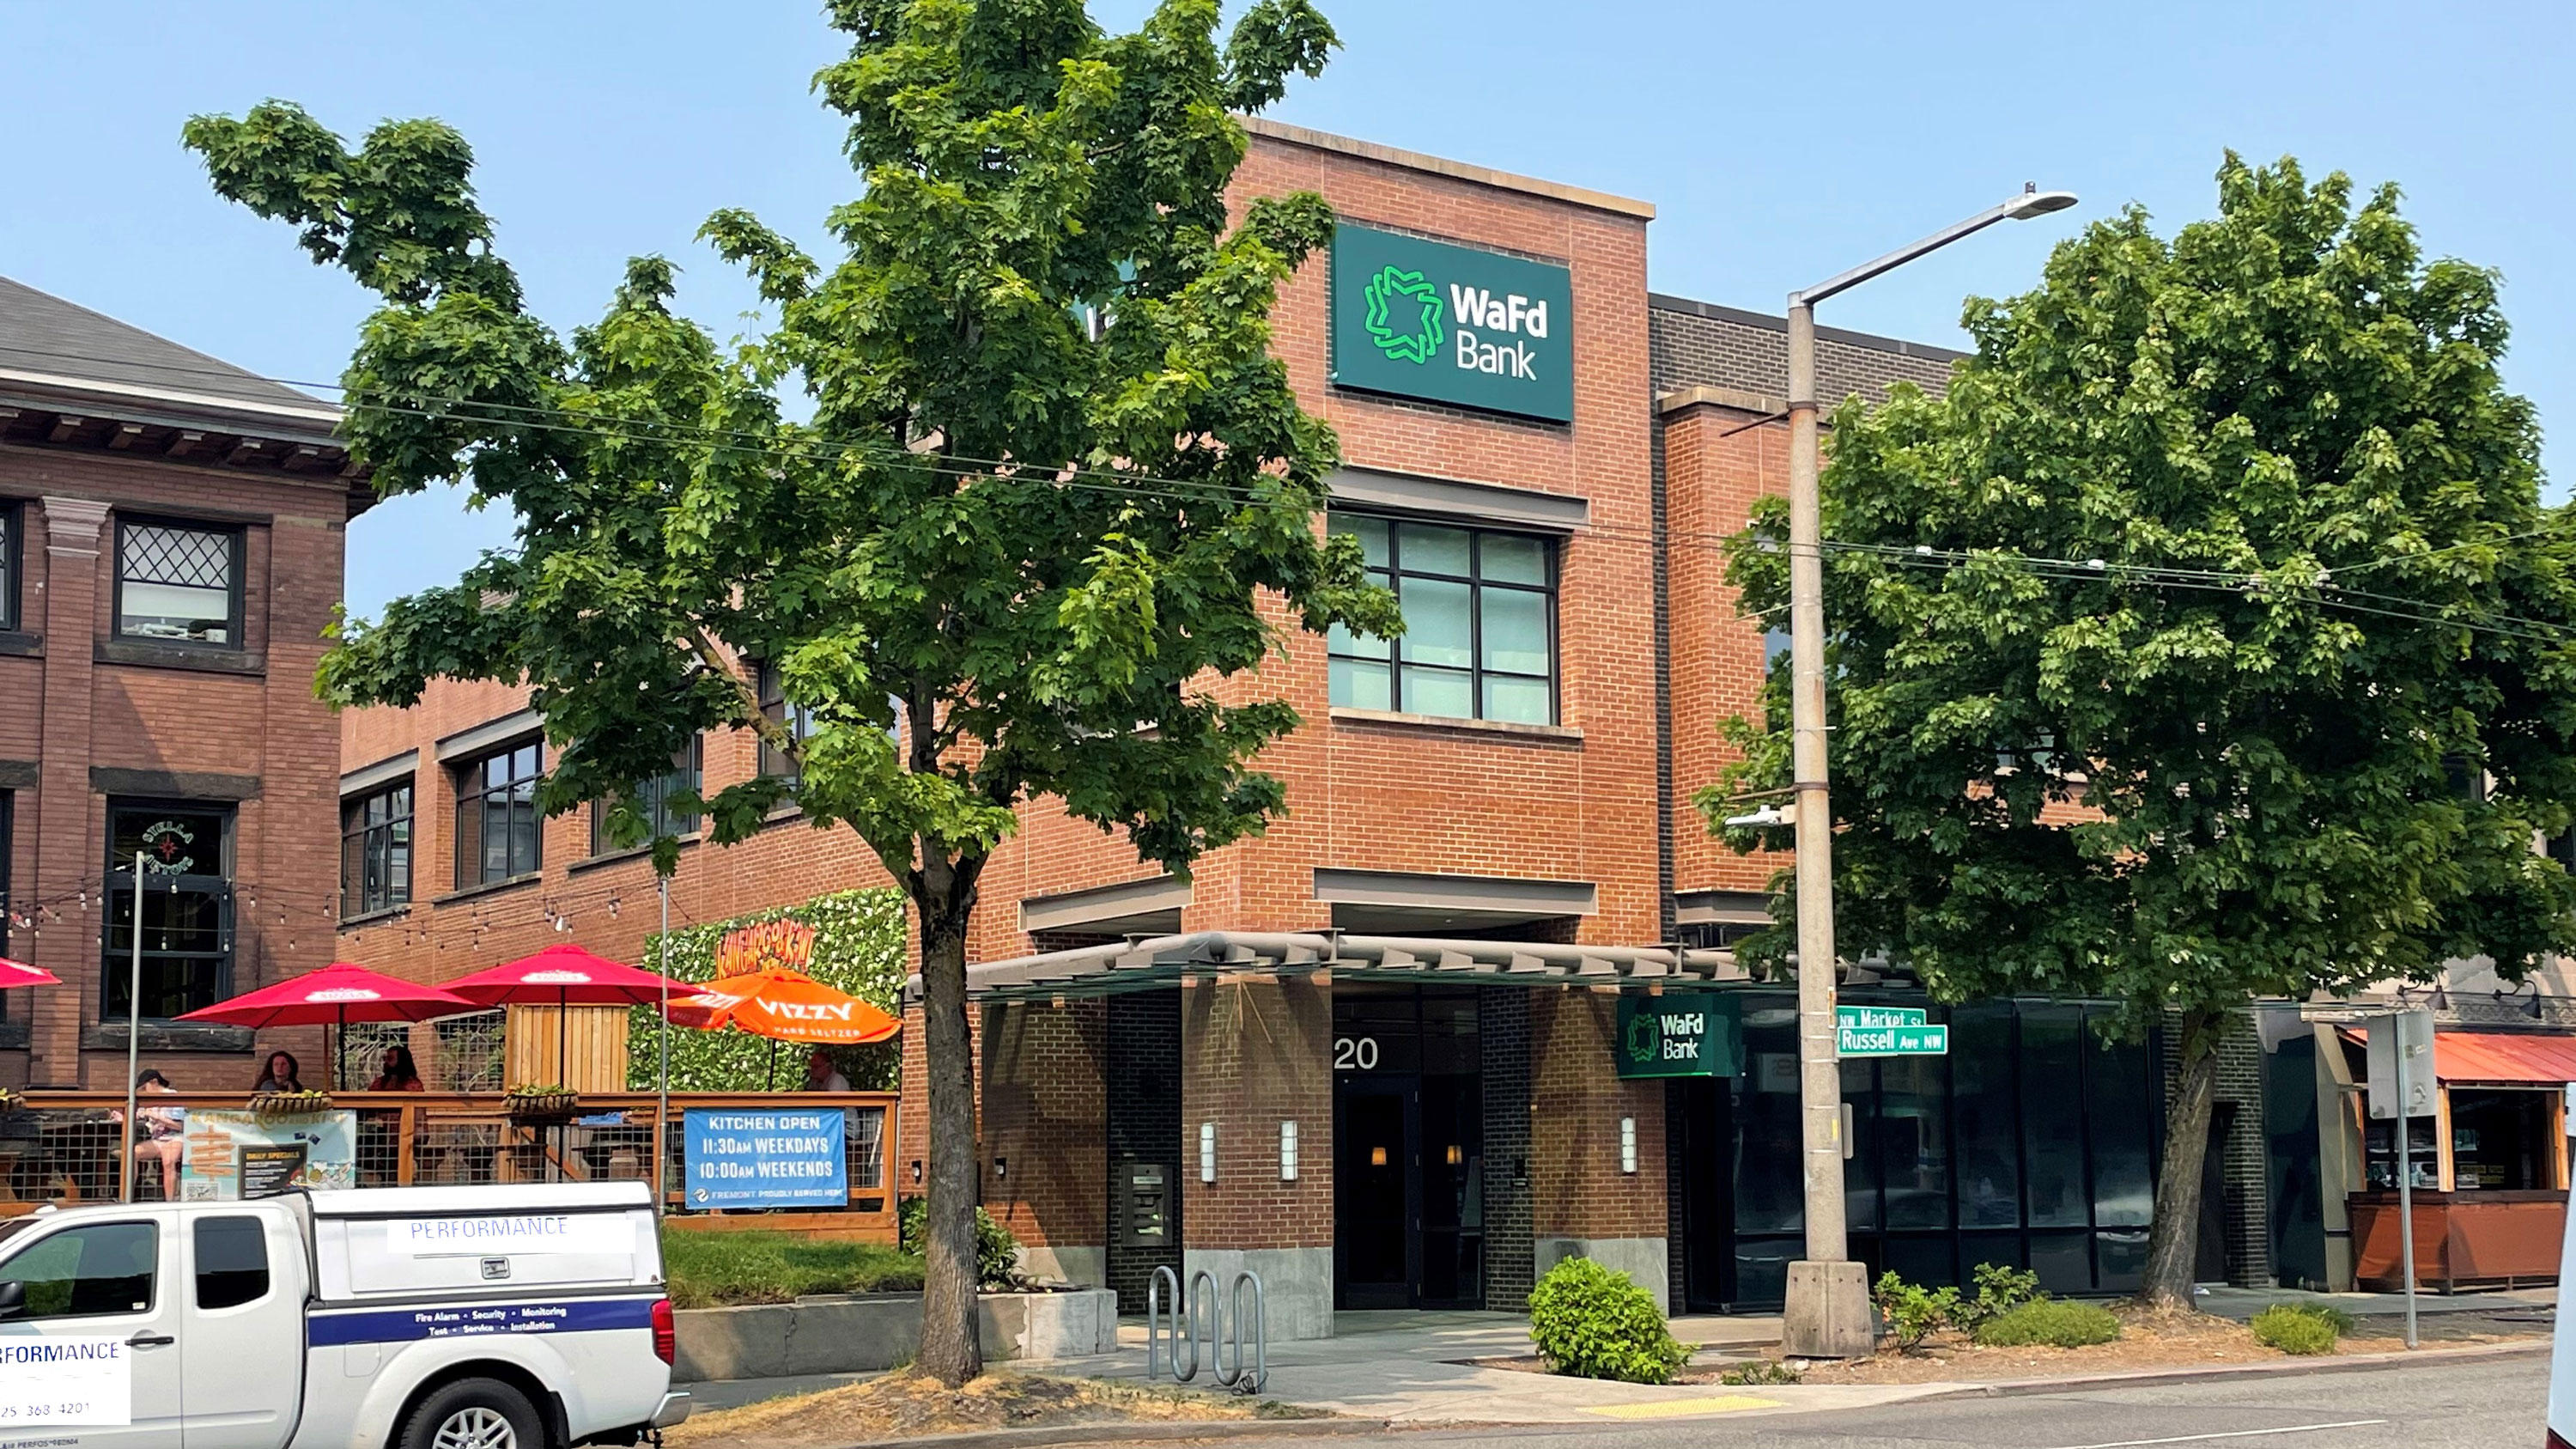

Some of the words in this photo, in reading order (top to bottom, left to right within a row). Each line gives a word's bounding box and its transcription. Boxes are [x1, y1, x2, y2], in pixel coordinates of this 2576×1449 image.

[1449, 283, 1548, 338] WaFd
[1456, 329, 1538, 381] Bank
[142, 820, 194, 843] STELLA
[755, 996, 854, 1021] VIZZY
[1839, 1014, 1856, 1026] NW
[1860, 1008, 1905, 1026] Market
[1911, 1017, 1922, 1026] St
[774, 1026, 805, 1036] HARD
[810, 1028, 860, 1038] SELTZER
[1661, 1014, 1704, 1036] WaFd
[1663, 1038, 1698, 1060] Bank
[1842, 1029, 1895, 1050] Russell
[1899, 1035, 1919, 1050] Ave
[1923, 1034, 1942, 1050] NW
[1334, 1038, 1378, 1069] 20
[708, 1117, 776, 1130] KITCHEN
[780, 1117, 820, 1130] OPEN
[702, 1138, 752, 1154] 11:30AM
[755, 1137, 829, 1154] WEEKDAYS
[700, 1162, 755, 1178] 10:00AM
[756, 1161, 833, 1178] WEEKENDS
[711, 1190, 756, 1200] FREMONT
[758, 1190, 793, 1198] PROUDLY
[793, 1189, 823, 1197] SERVED
[410, 1216, 568, 1239] PERFORMANCE
[415, 1312, 433, 1323] Fire
[434, 1312, 459, 1322] Alarm
[472, 1310, 507, 1321] Security
[521, 1306, 567, 1318] Monitoring
[428, 1326, 448, 1336] Test
[463, 1324, 495, 1333] Service
[510, 1321, 556, 1331] Installation
[27, 1404, 51, 1416] 368
